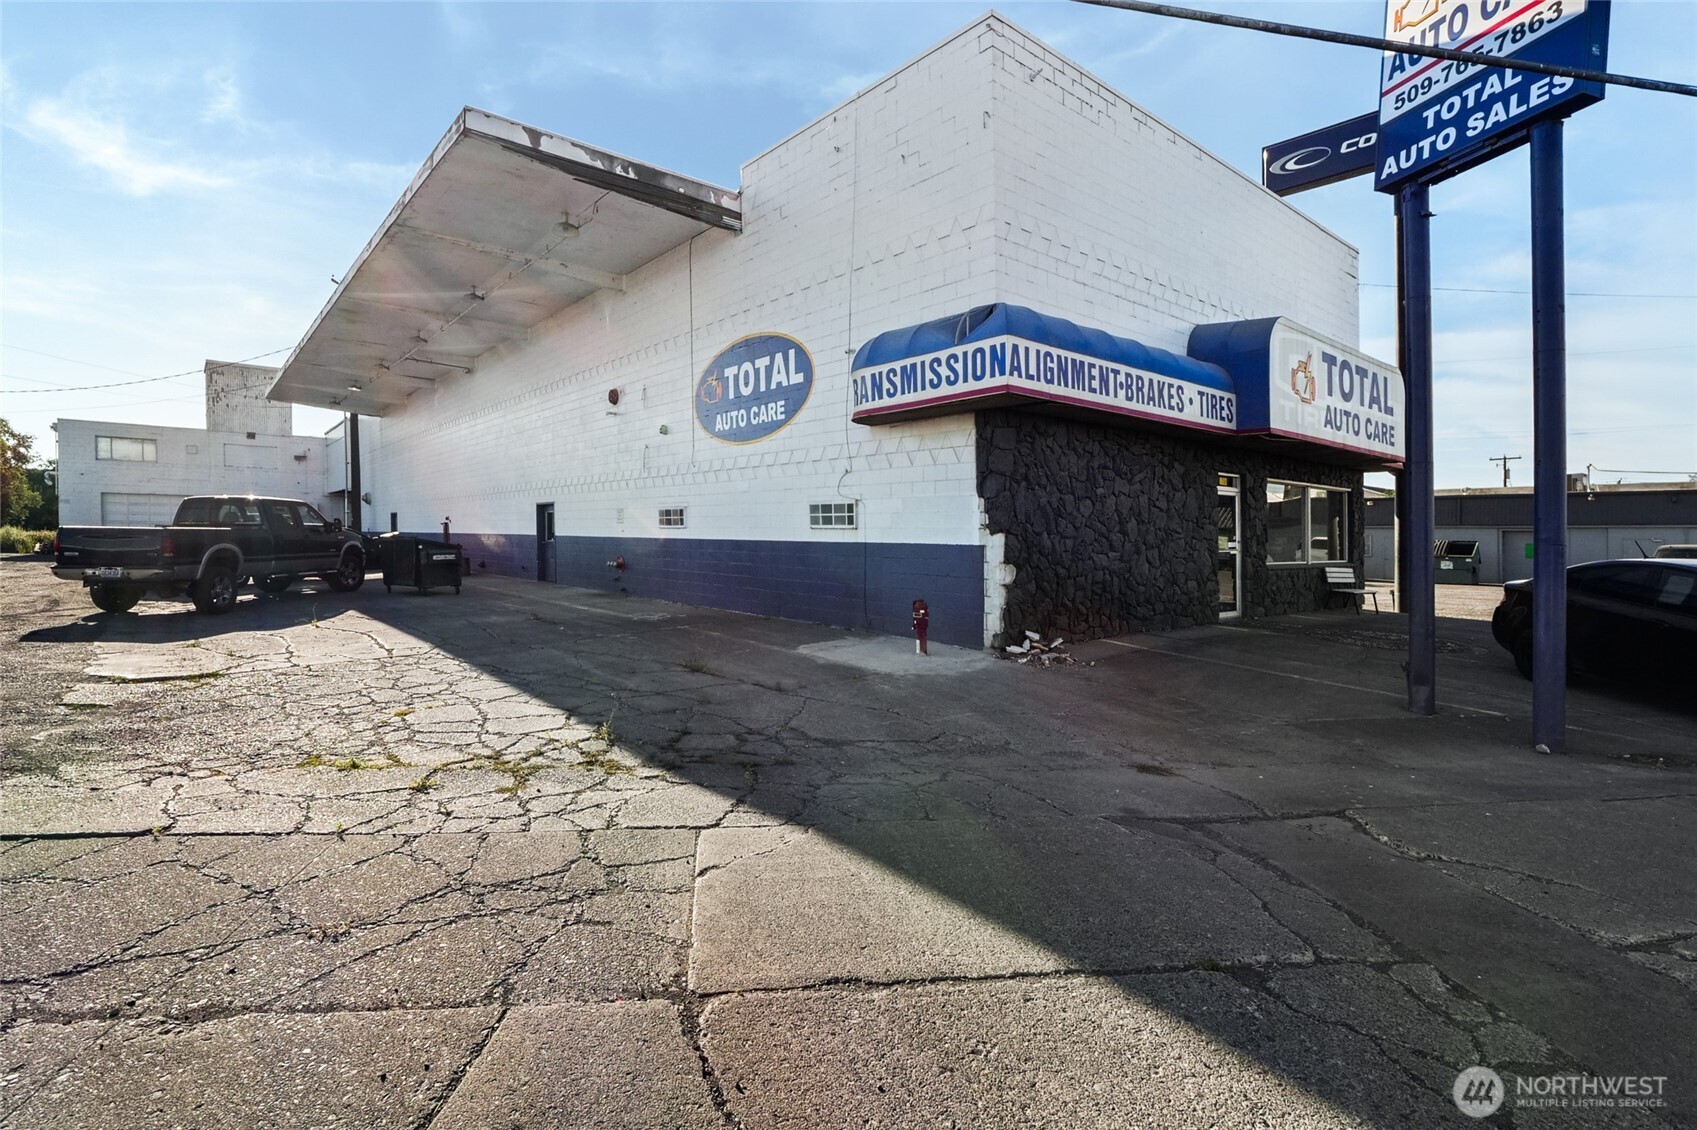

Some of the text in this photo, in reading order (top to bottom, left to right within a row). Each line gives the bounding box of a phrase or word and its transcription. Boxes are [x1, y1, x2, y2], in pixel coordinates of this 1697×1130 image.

[1388, 3, 1469, 82] AUTO
[1394, 1, 1564, 111] 509-765-7863
[1380, 75, 1574, 180] AUTO SALES
[1422, 68, 1522, 130] TOTAL
[724, 348, 804, 399] TOTAL
[1321, 351, 1394, 417] TOTAL
[715, 400, 785, 432] AUTO CARE
[1197, 390, 1234, 424] TIRES
[1324, 405, 1395, 447] AUTO CARE
